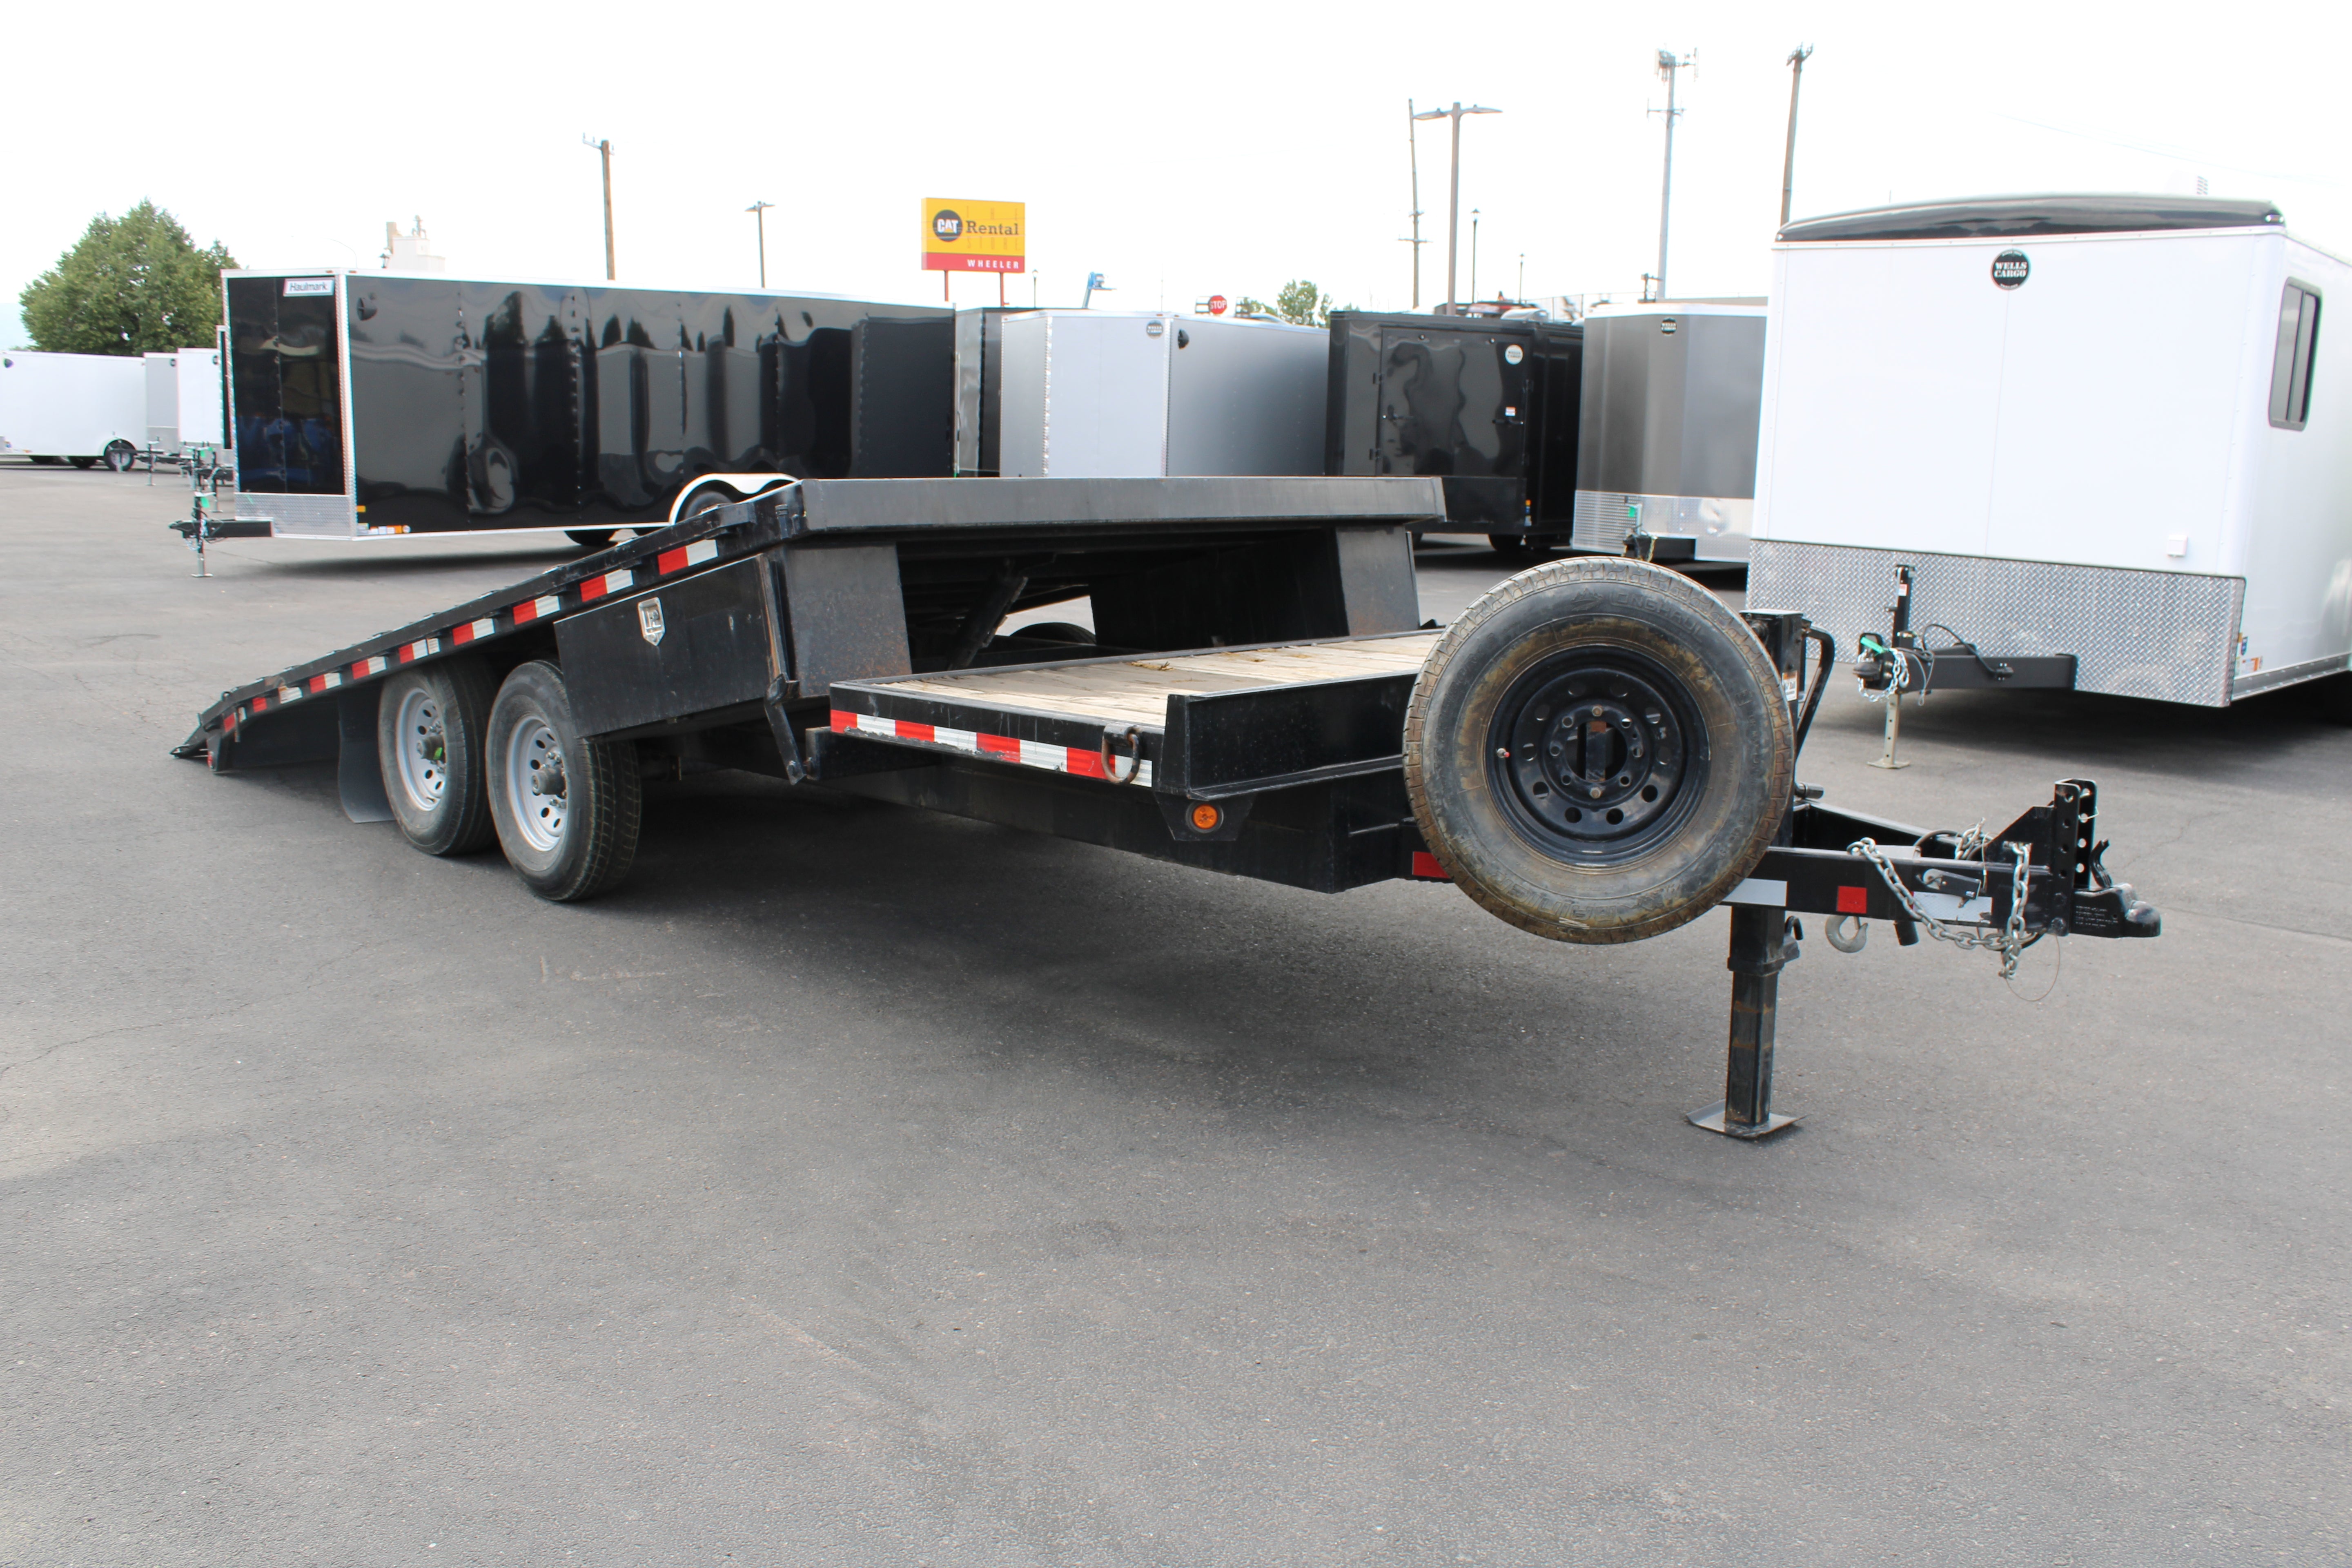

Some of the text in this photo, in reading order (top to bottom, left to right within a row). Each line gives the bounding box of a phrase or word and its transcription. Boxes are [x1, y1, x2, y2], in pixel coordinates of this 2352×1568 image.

[937, 218, 959, 233] CAT
[966, 220, 1019, 235] Rental
[967, 259, 1019, 269] WHEELER
[1993, 270, 2027, 278] CARGO
[289, 282, 327, 292] Haulmark
[1210, 300, 1227, 309] STOP
[1610, 592, 1703, 643] LONGHAUL
[1488, 869, 1617, 922] RAINIER
